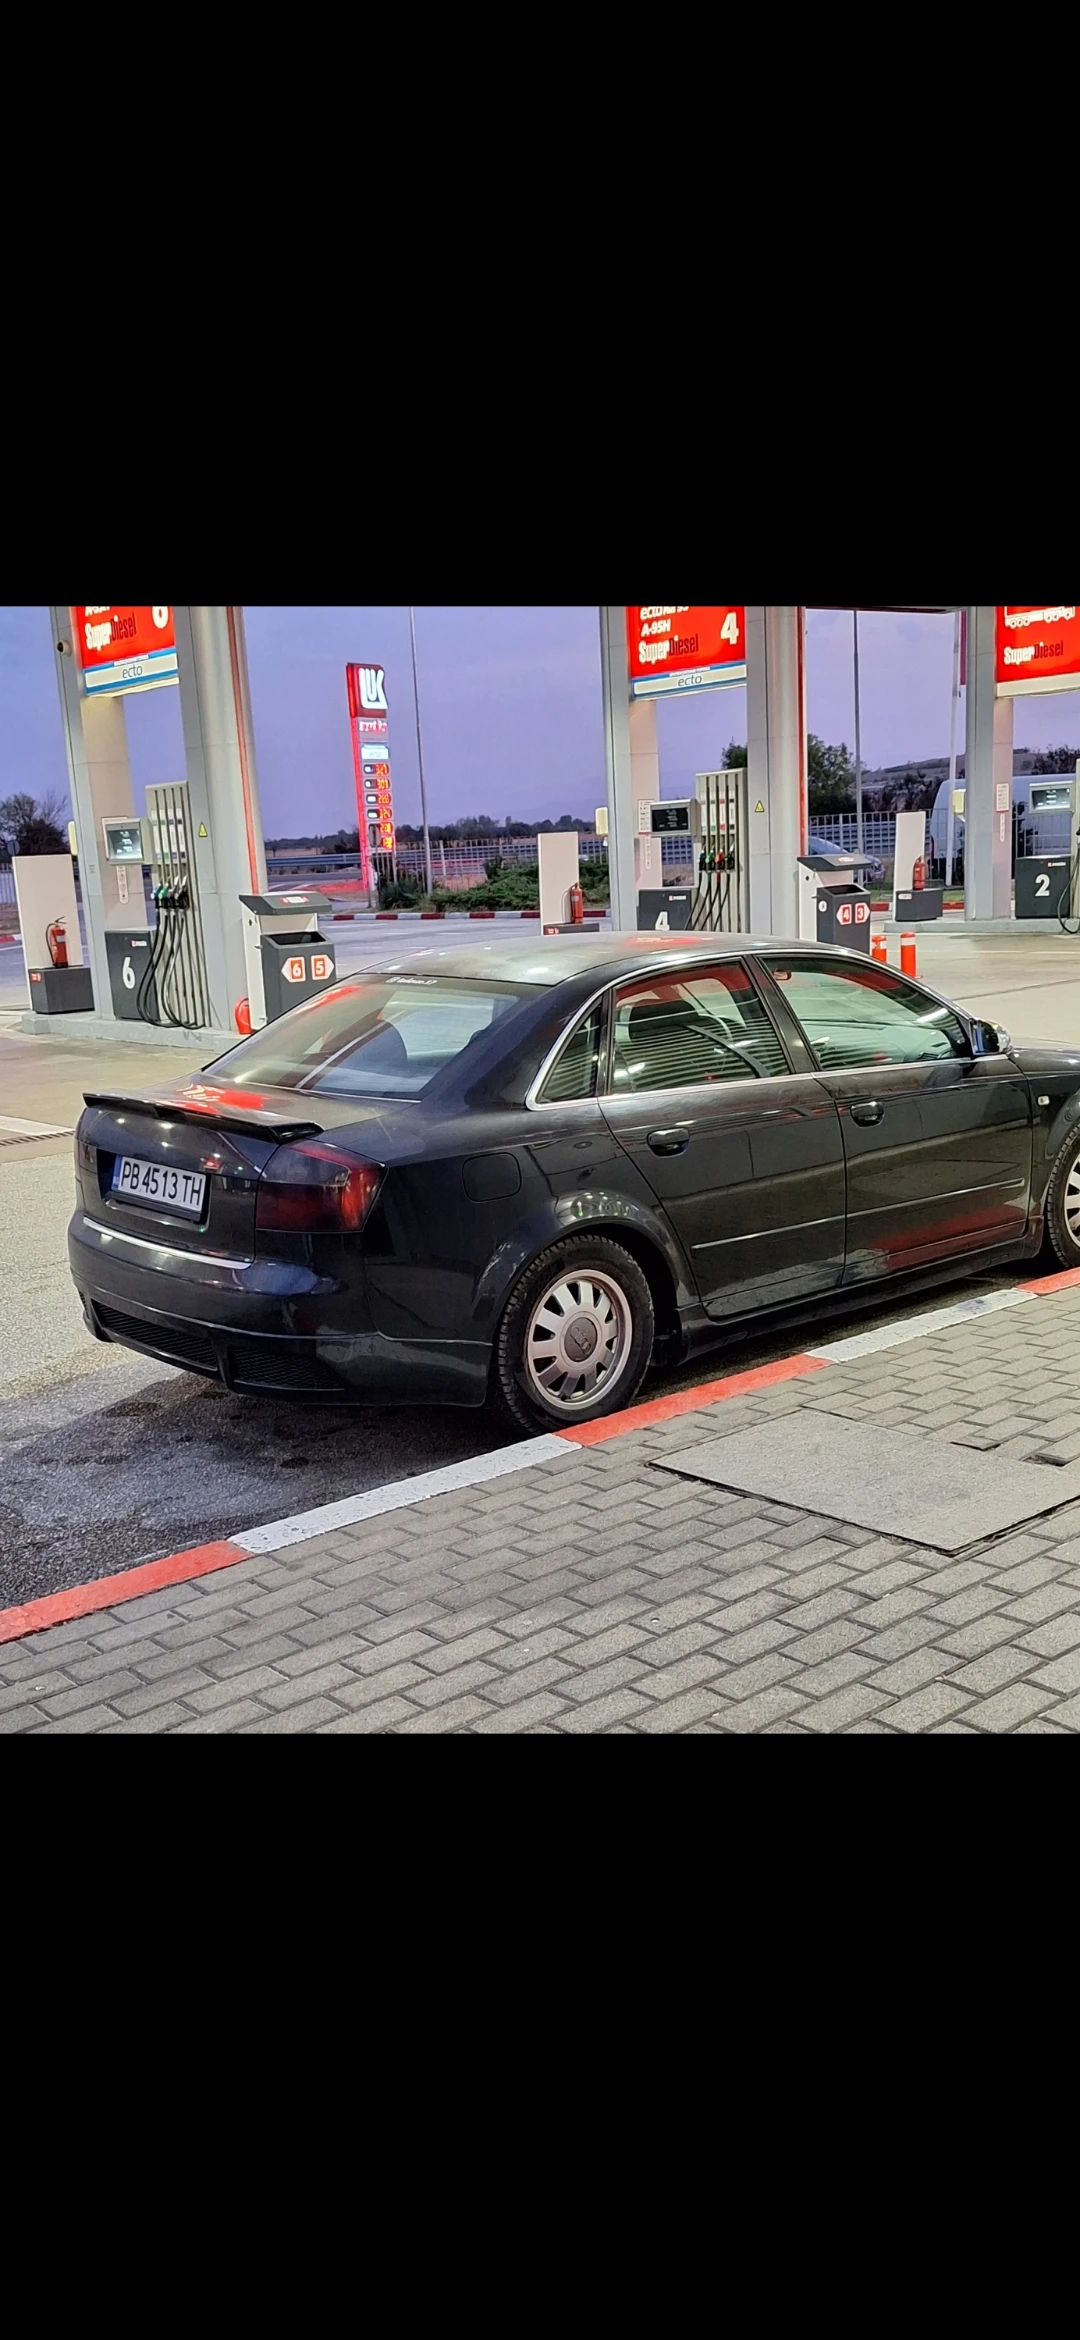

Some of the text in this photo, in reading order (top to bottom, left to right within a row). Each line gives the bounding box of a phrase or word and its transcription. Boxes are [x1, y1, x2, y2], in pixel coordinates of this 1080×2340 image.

[640, 619, 671, 637] A-95H
[720, 612, 739, 645] 4
[122, 665, 143, 679] ecto
[677, 675, 703, 687] ecto
[1035, 873, 1050, 896] 2
[655, 911, 670, 931] 4
[843, 909, 850, 921] 4
[857, 907, 864, 920] 3
[122, 956, 136, 989] 6
[292, 962, 302, 977] 6
[314, 960, 324, 975] 5
[121, 1161, 140, 1190] PB
[141, 1166, 178, 1200] 4513
[182, 1174, 203, 1206] TH
